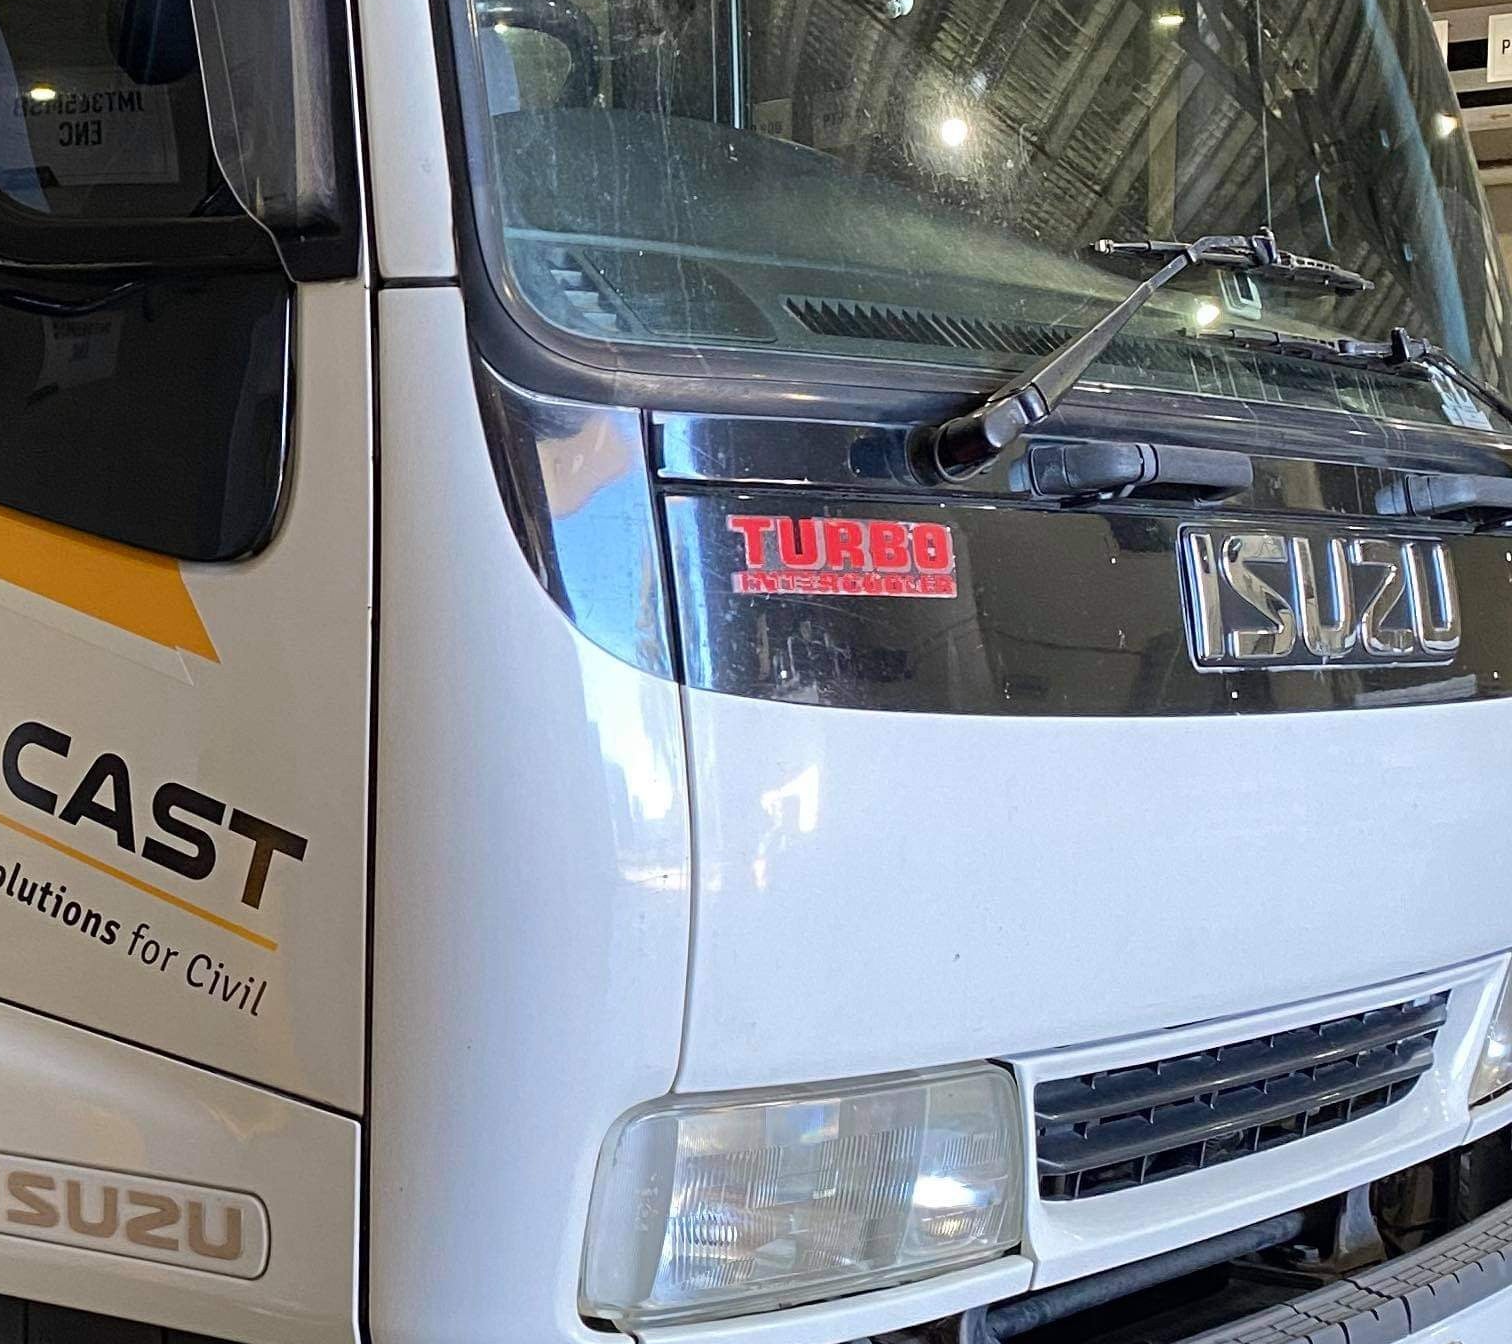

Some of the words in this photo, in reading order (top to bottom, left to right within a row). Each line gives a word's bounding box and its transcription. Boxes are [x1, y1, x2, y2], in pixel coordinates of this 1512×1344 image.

[729, 515, 954, 574] TURBO
[1189, 532, 1462, 658] ISUZU
[127, 923, 179, 972] for
[185, 953, 268, 1017] Civil
